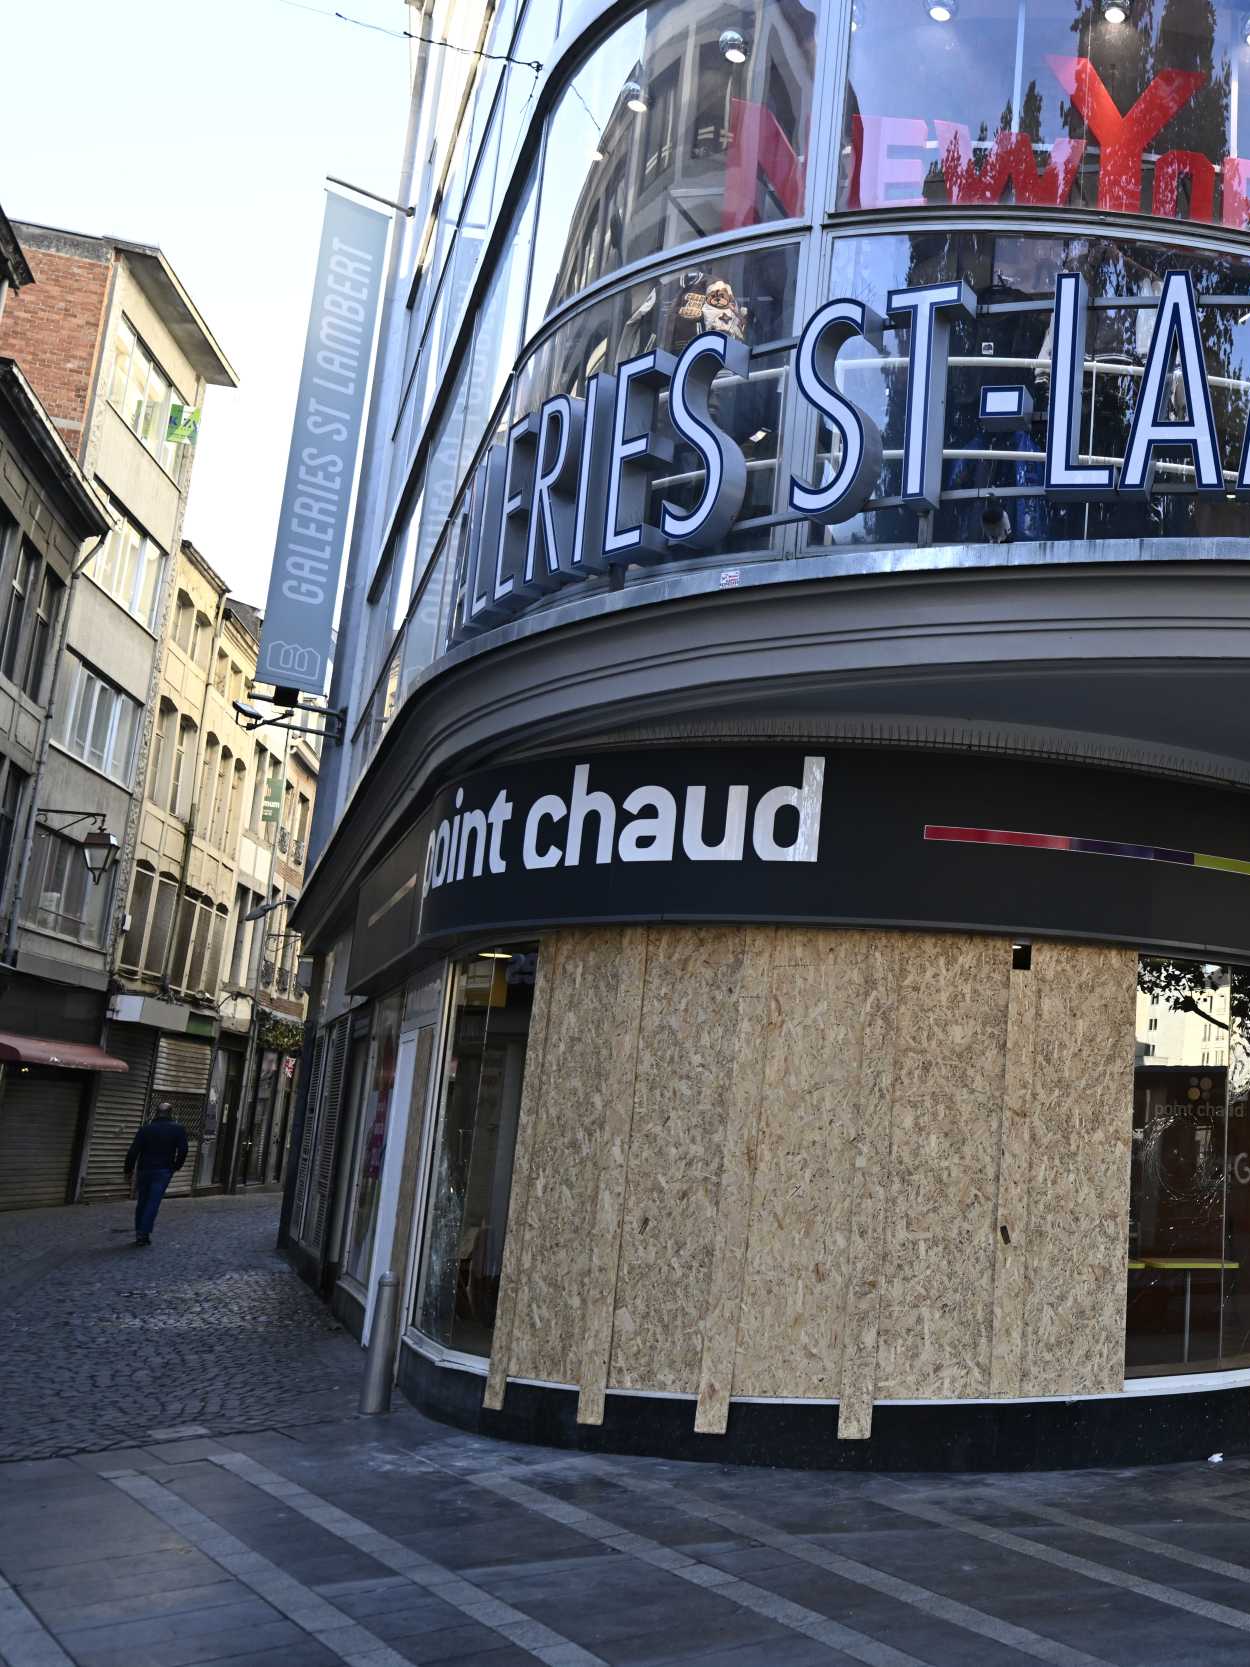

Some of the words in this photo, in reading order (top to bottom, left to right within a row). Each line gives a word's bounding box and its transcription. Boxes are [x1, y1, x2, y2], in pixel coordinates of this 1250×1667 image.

[312, 236, 374, 396] LAMBERT
[306, 396, 351, 442] ST
[281, 447, 344, 605] GALERIES
[522, 756, 826, 870] chaud
